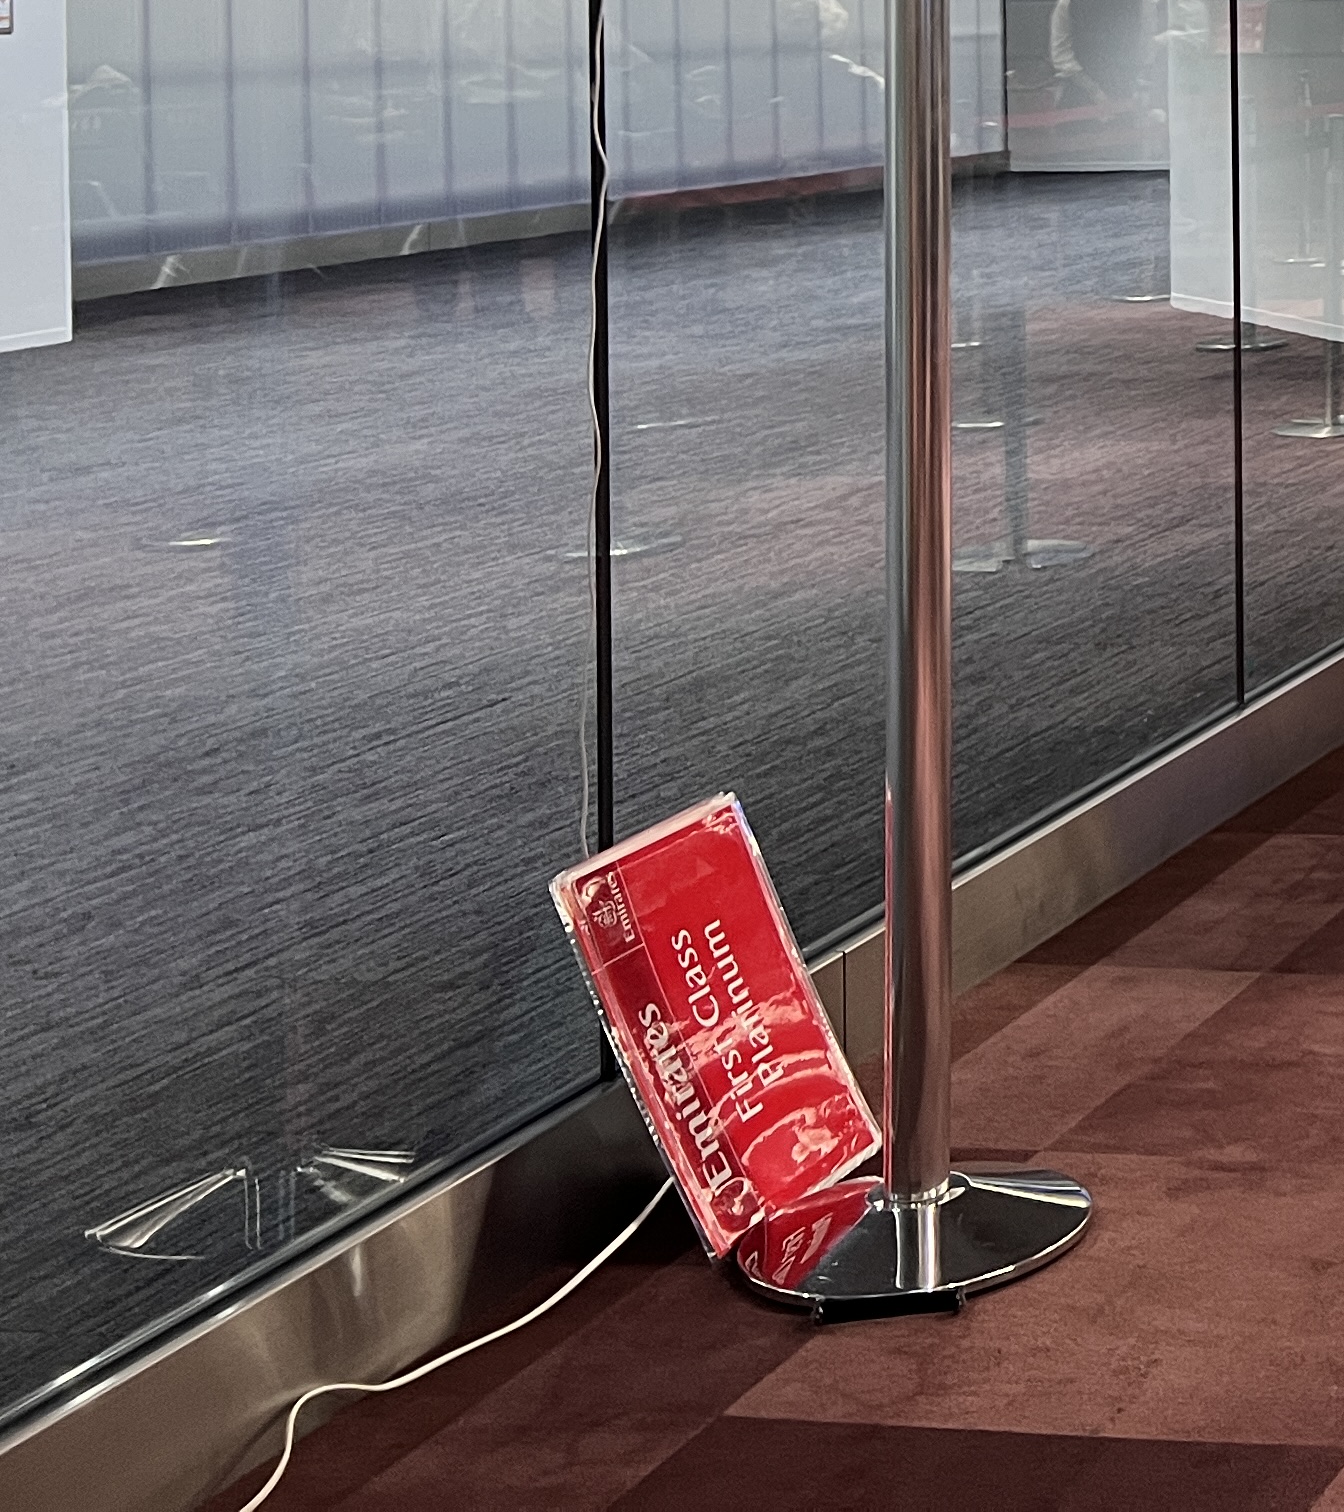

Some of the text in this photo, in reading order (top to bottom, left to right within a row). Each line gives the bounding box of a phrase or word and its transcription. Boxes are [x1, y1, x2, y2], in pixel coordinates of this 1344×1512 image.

[638, 1002, 733, 1198] Emirates
[671, 929, 765, 1123] First Class
[704, 918, 784, 1088] Platinum
